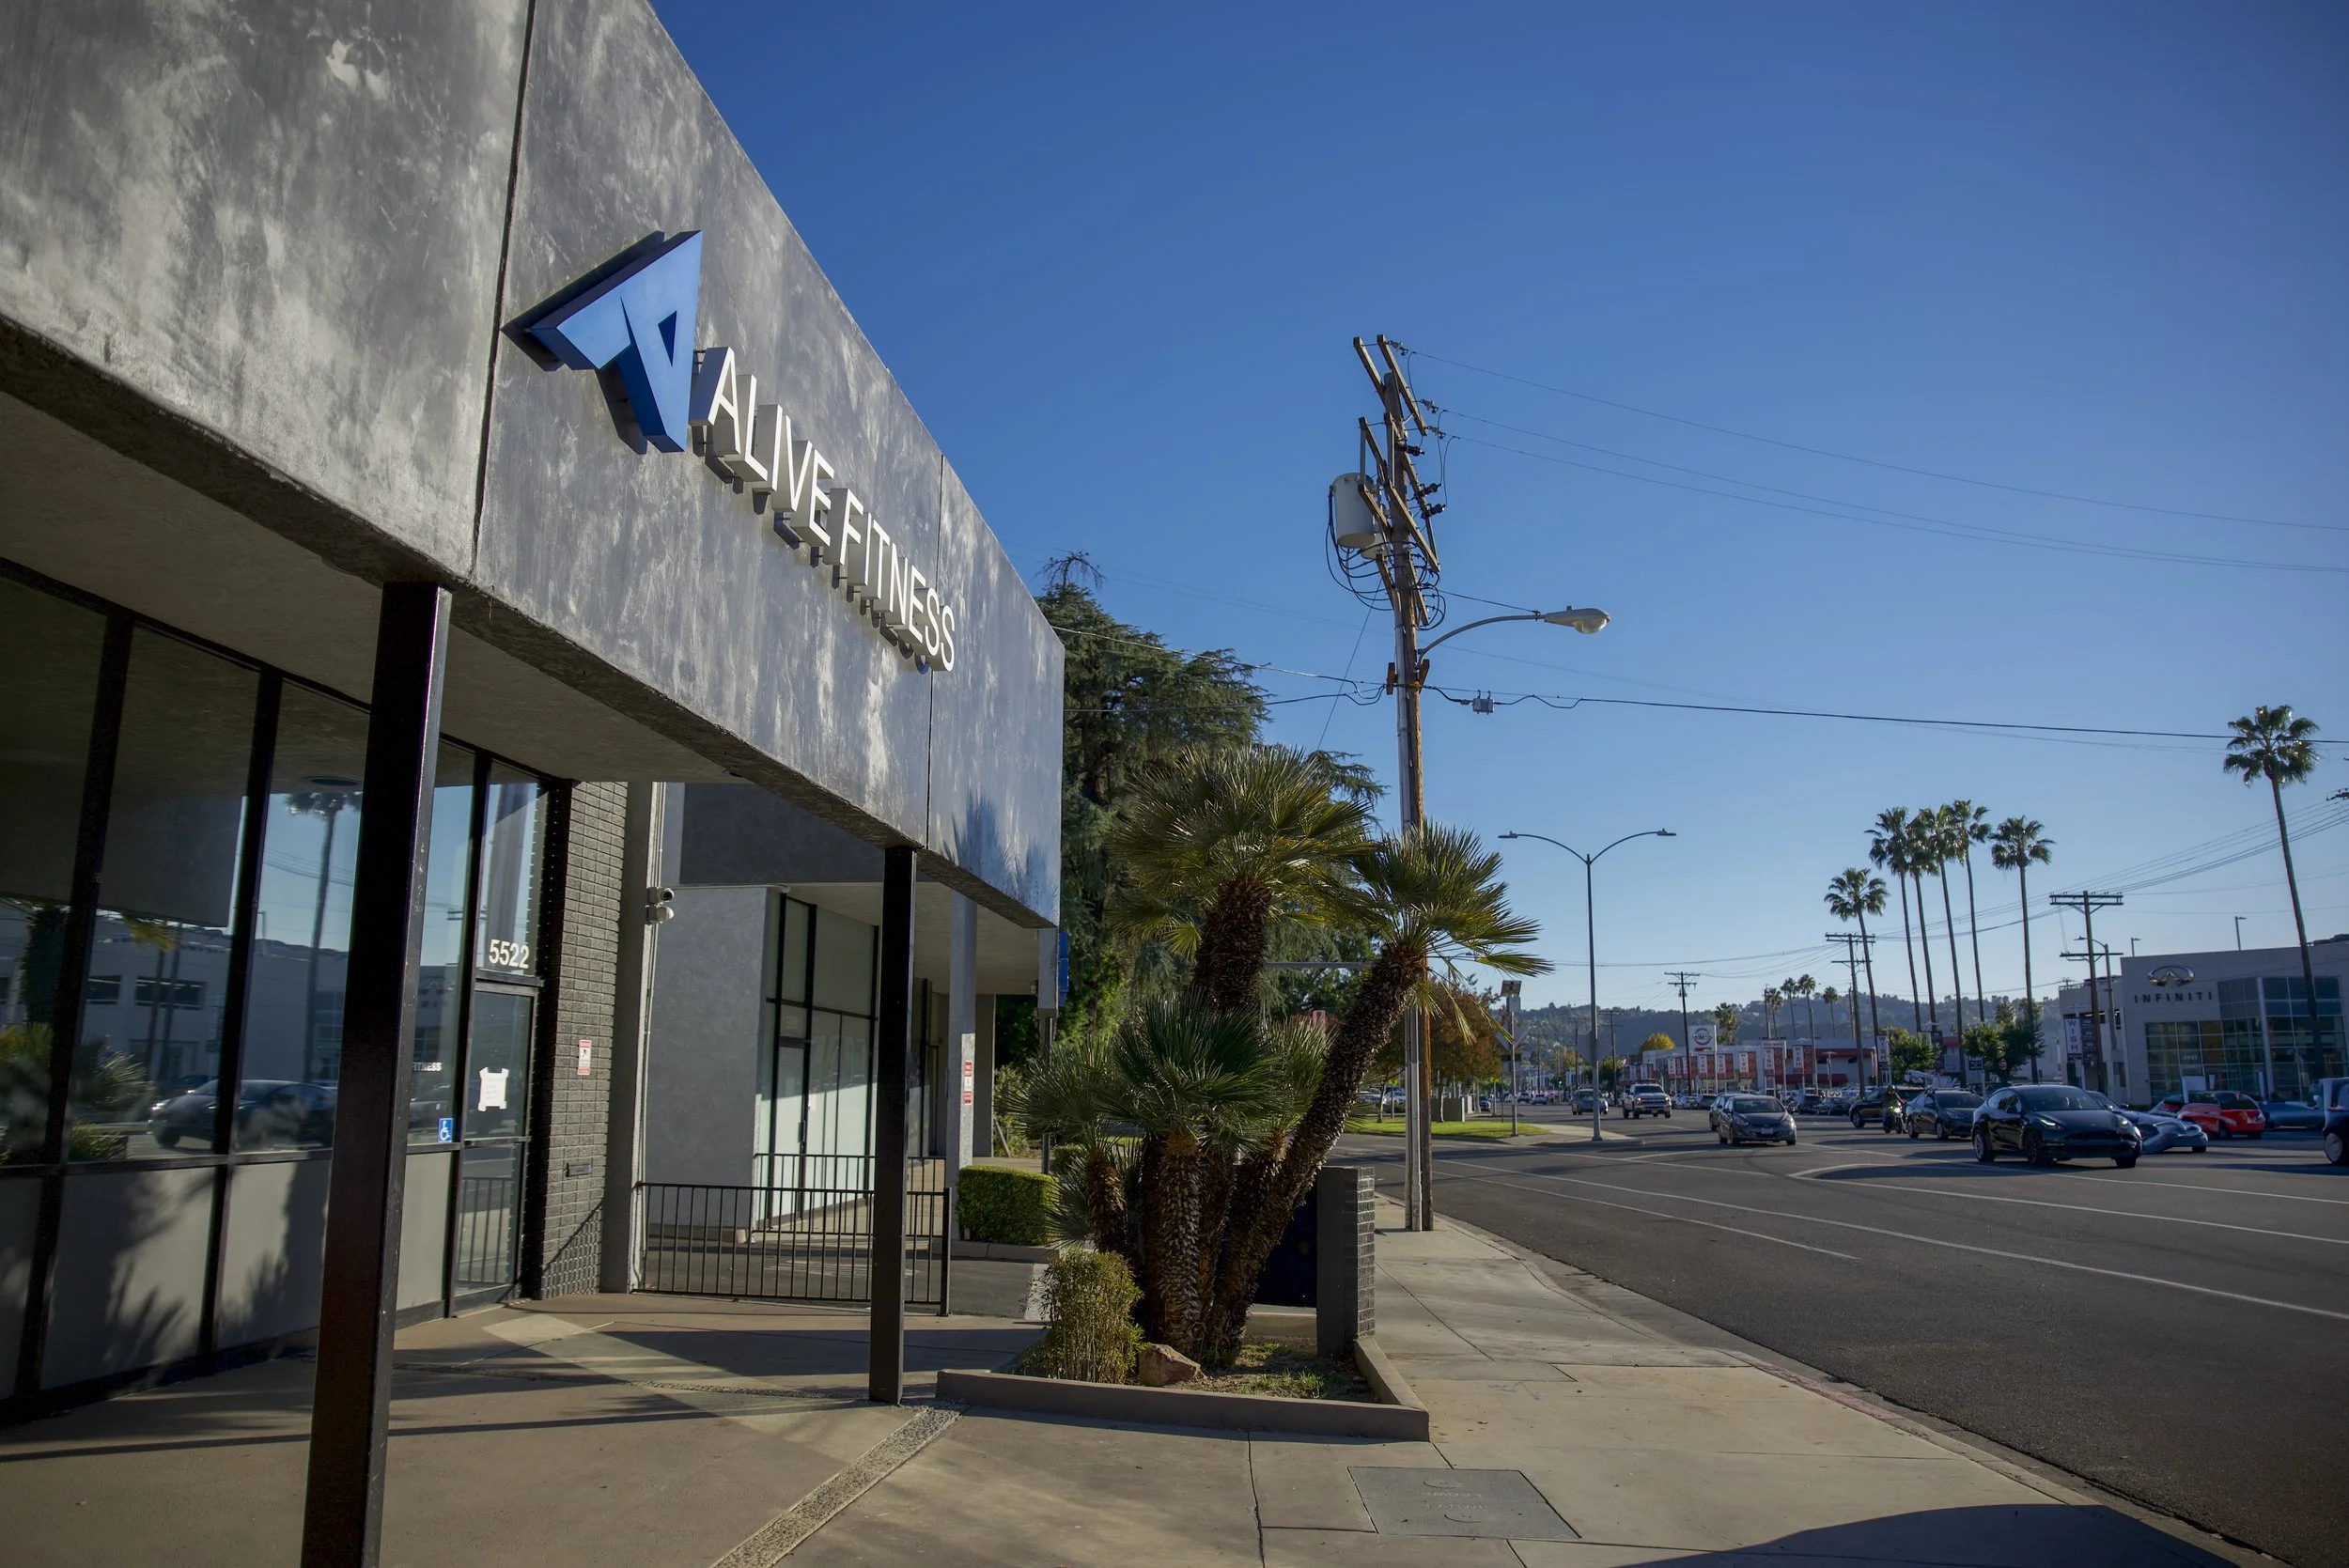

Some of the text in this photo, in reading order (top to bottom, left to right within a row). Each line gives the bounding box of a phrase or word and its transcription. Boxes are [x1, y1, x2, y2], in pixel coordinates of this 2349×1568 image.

[707, 346, 956, 672] ALIVE FITNESS
[489, 939, 530, 969] 5522
[2134, 991, 2213, 1003] INFINITI
[2067, 1019, 2078, 1051] WISH
